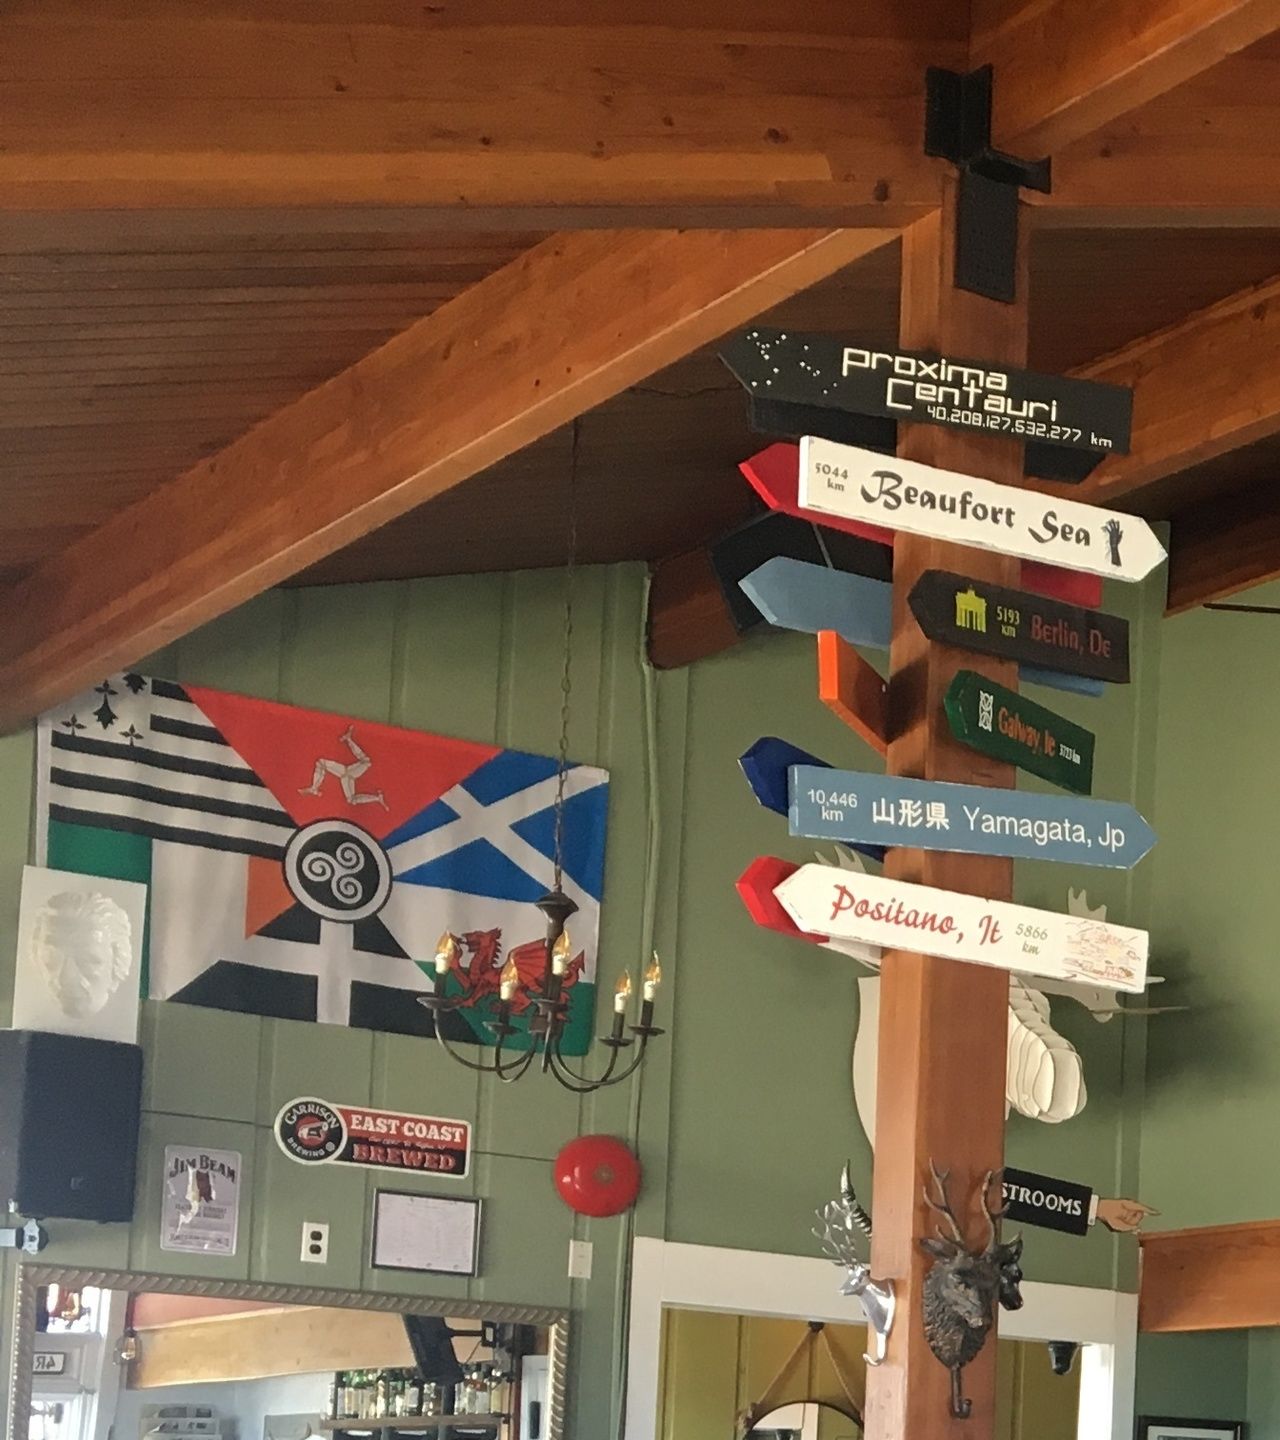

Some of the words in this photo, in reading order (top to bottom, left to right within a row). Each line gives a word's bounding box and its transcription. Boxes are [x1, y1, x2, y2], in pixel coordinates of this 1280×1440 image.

[1090, 432, 1113, 449] km
[815, 463, 849, 480] 5044
[827, 478, 845, 492] km
[860, 470, 1015, 529] Beaufort
[1028, 511, 1091, 547] Sea
[996, 605, 1020, 626] 5193
[1031, 614, 1084, 655] Berlin,
[1089, 628, 1112, 658] De
[807, 789, 858, 808] 10,446
[821, 807, 844, 822] km
[872, 797, 950, 831] 山形県
[962, 804, 1093, 848] Yamagata,
[1098, 821, 1126, 853] Jp
[829, 884, 964, 944] Positano,
[978, 914, 1003, 946] It
[1014, 921, 1049, 942] 5866
[1022, 941, 1041, 956] km
[284, 1103, 340, 1130] GARRISON
[351, 1114, 401, 1136] EAST
[403, 1120, 465, 1143] COAST
[286, 1136, 326, 1158] BREWING
[352, 1143, 457, 1171] BREWED
[169, 1157, 197, 1178] JIM
